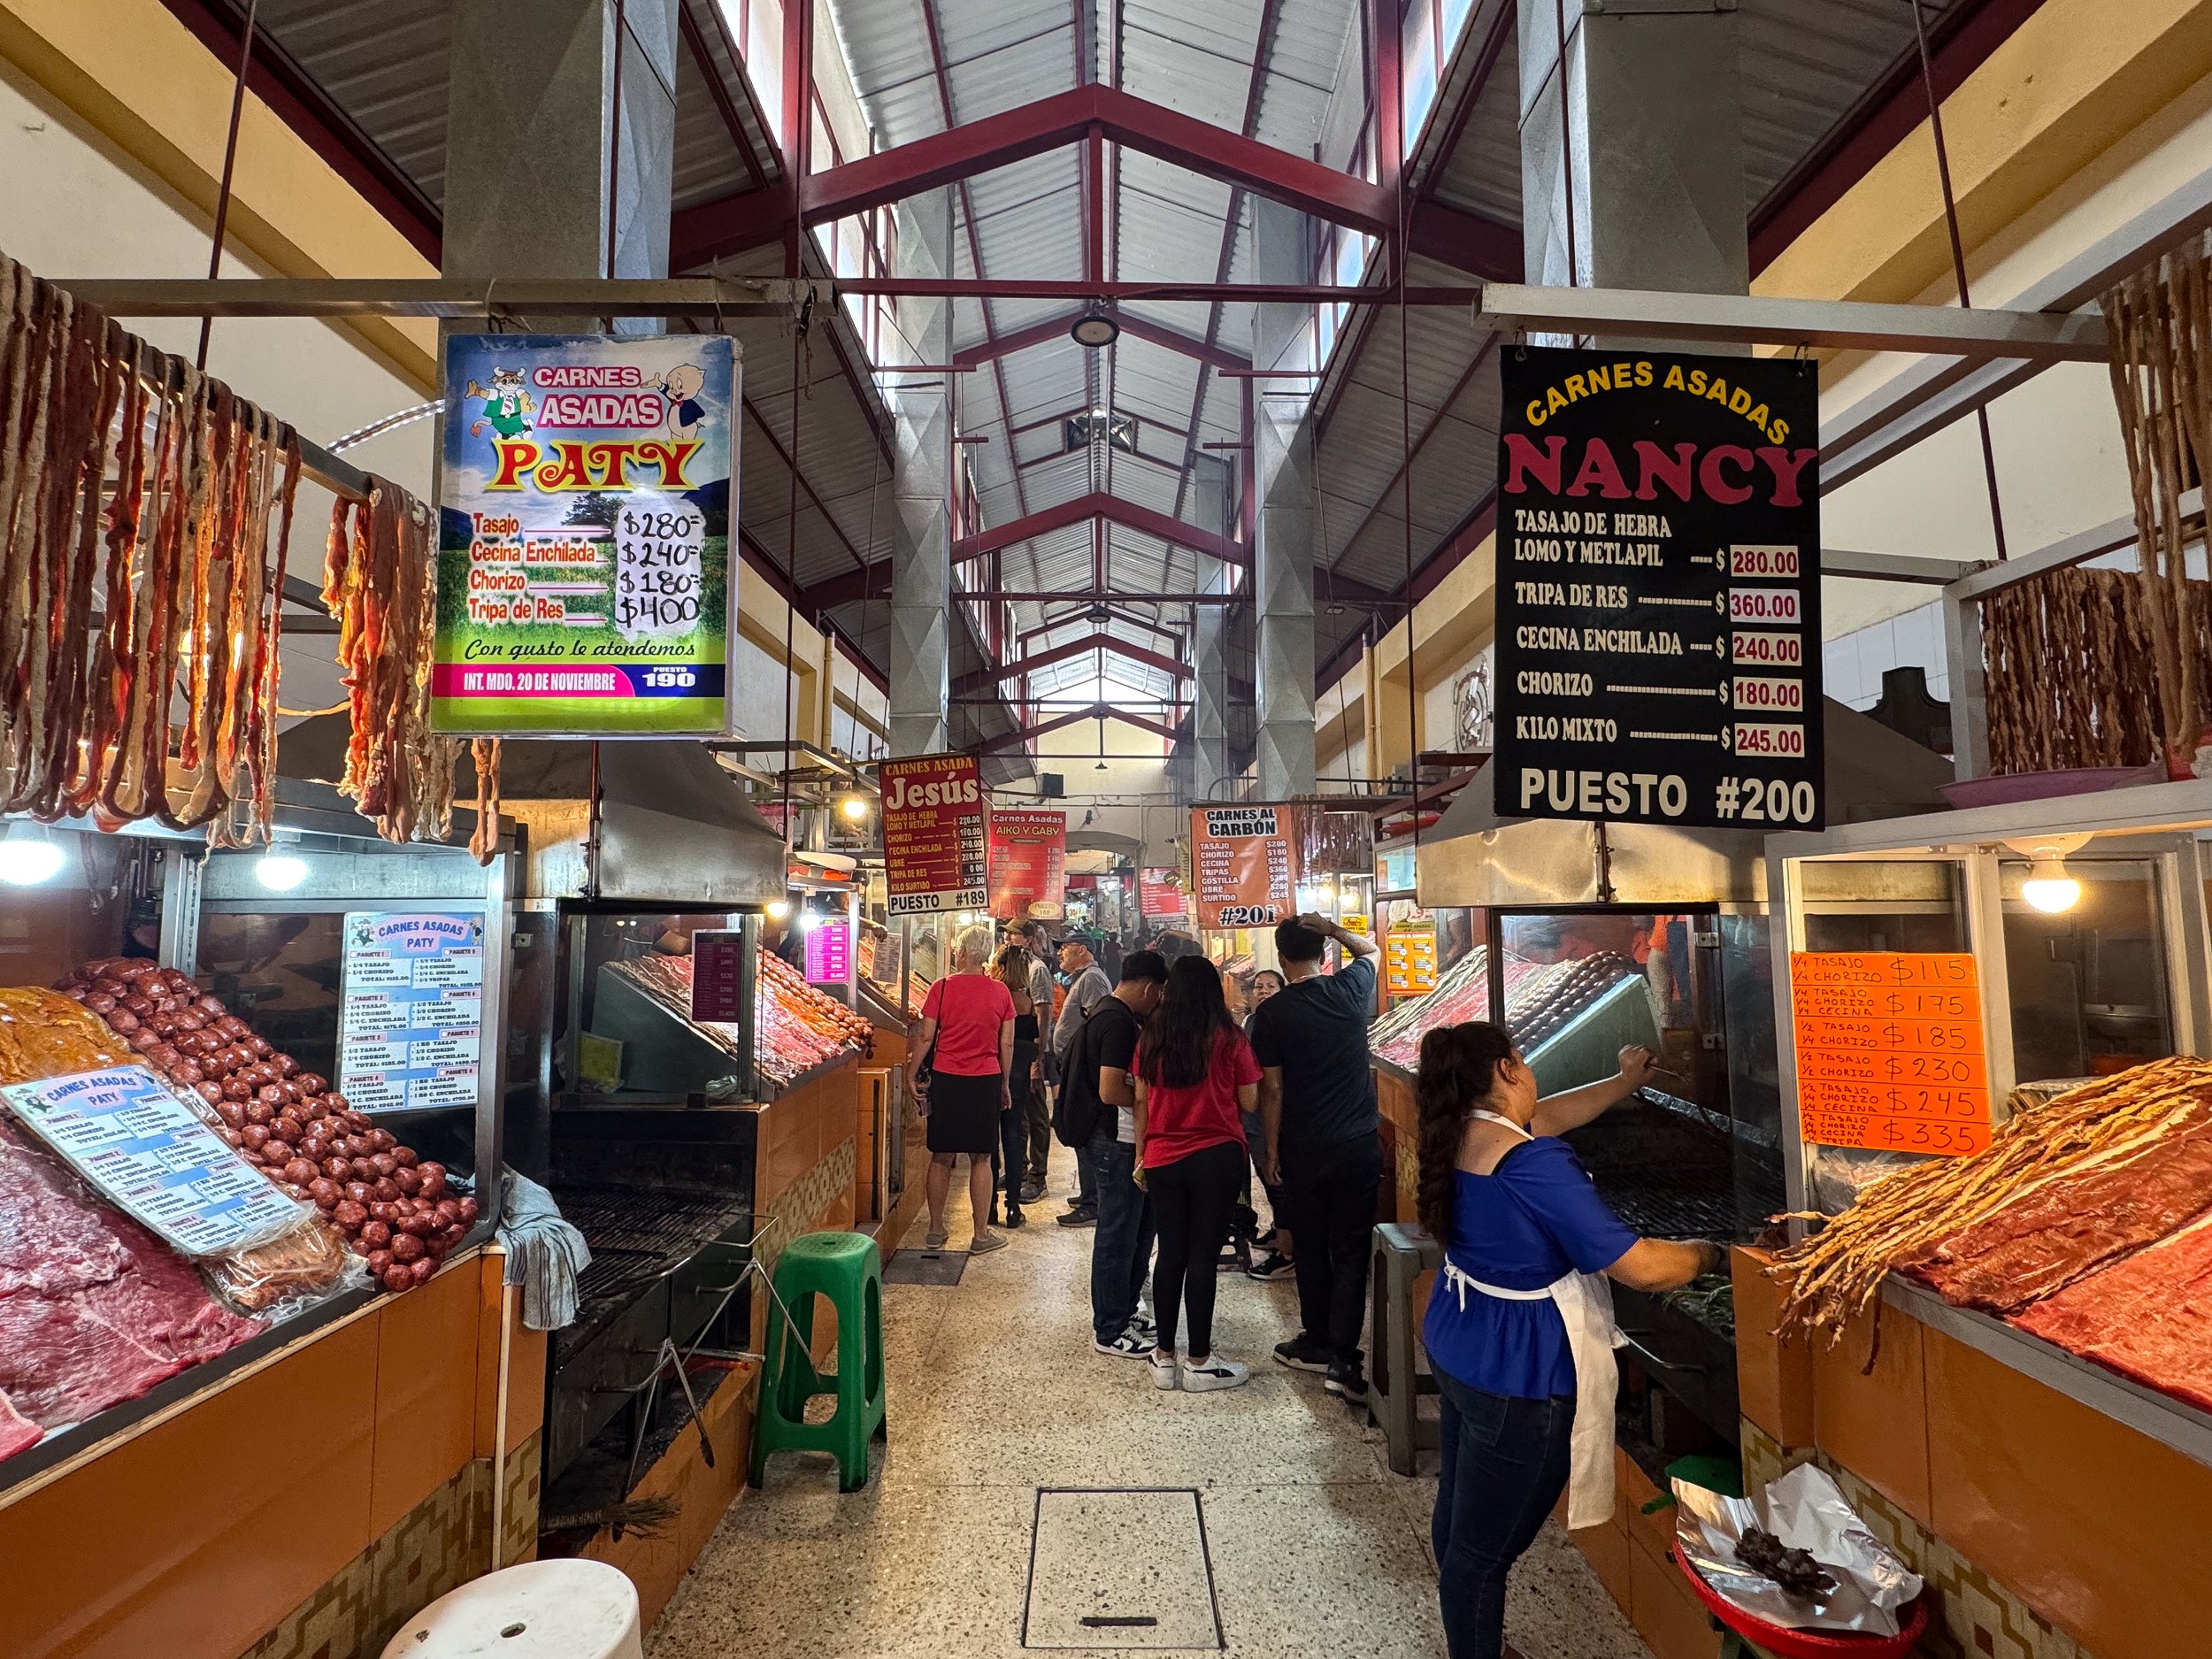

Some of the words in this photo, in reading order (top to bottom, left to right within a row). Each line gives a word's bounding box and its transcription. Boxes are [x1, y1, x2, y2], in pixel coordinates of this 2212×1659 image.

[534, 367, 641, 387] CARNES
[1526, 361, 1653, 426] CARNES
[1663, 365, 1790, 445] ASADAS
[538, 396, 662, 426] ASADAS
[486, 440, 703, 490] PATY
[1503, 433, 1817, 507] NANCY
[472, 513, 519, 537] Tasajo
[1515, 509, 1580, 534] TASAJO
[1585, 512, 1607, 535] DE
[1614, 513, 1672, 538] HEBRA
[472, 541, 520, 562] Cecina
[526, 541, 595, 562] Enchilada
[1515, 538, 1561, 563] LOMO
[1564, 540, 1577, 563] Y
[1580, 541, 1663, 567] METLAPIL
[1732, 551, 1797, 573] 280.00
[470, 569, 526, 590] Chorizo
[1515, 581, 1566, 606] TRIPA
[1569, 584, 1593, 607] DE
[1595, 585, 1628, 609] RES
[1731, 594, 1795, 618] 360.00
[469, 598, 507, 623] Tripa
[513, 598, 531, 618] de
[536, 599, 564, 618] Res
[618, 596, 701, 629] $400
[465, 640, 503, 660] Con
[508, 641, 565, 661] gusto
[569, 640, 586, 657] le
[591, 640, 695, 657] atendemos
[1517, 626, 1580, 651] CECINA
[1584, 628, 1683, 655] ENCHILADA
[1733, 636, 1800, 662] 240.00
[464, 672, 484, 691] INT.
[488, 672, 515, 691] MDO.
[518, 672, 531, 690] 20
[534, 672, 549, 690] DE
[550, 672, 616, 690] NOVIEMBRE
[641, 673, 696, 687] 190
[1517, 671, 1593, 696] CHORIZO
[1735, 681, 1801, 707] 180.00
[1516, 716, 1558, 740] KILO
[1562, 718, 1617, 742] MIXTO
[1737, 728, 1801, 753] 245.00
[885, 761, 930, 776] CARNES
[934, 757, 973, 772] ASADA
[886, 772, 979, 810] Jesús
[1521, 767, 1687, 817] PUESTO
[1716, 777, 1815, 823] #200
[887, 812, 907, 822] TASAJO
[909, 811, 916, 821] DE
[918, 810, 938, 820] HEBRA
[993, 814, 1025, 823] Carnes
[1028, 814, 1063, 824] Asadas
[1206, 809, 1257, 821] CARNES
[1259, 809, 1275, 818] AL
[887, 822, 902, 831] LOMO
[903, 821, 908, 830] Y
[909, 819, 936, 829] METLAPIL
[996, 826, 1020, 835] AIKO
[1022, 826, 1031, 835] Y
[1032, 826, 1060, 836] GABY
[1209, 819, 1276, 836] CARBÓN
[887, 833, 912, 843] CHORIZO
[911, 843, 942, 853] ENCHILADA
[890, 858, 904, 867] UBRE
[890, 870, 907, 879] TRIPA
[908, 869, 915, 878] DE
[917, 868, 927, 877] RES
[891, 882, 905, 892] KILO
[906, 881, 930, 891] SURTIDO
[891, 894, 940, 911] PUESTO
[956, 890, 985, 906] #189
[1219, 906, 1276, 926] #201
[379, 920, 419, 936] CARNES
[423, 921, 464, 935] ASADAS
[407, 938, 434, 948] PATY
[1813, 957, 1863, 968] TASAJO
[1814, 971, 1882, 983] CHORIZO
[1813, 988, 1867, 997] TASAJO
[1815, 997, 1874, 1006] CHORIZO
[1819, 1007, 1872, 1016] CECINA
[1801, 1020, 1815, 1033] 1/2
[1823, 1022, 1870, 1033] TASAJO
[1820, 1035, 1878, 1048] CHORIZO
[1801, 1051, 1812, 1061] 1/2
[1817, 1053, 1870, 1064] TASAJO
[1802, 1064, 1814, 1076] 1/2
[1820, 1068, 1874, 1078] CHORIZO
[47, 1080, 89, 1102] CARNES
[90, 1077, 137, 1087] ASADAS
[1819, 1083, 1869, 1094] TASAJO
[88, 1092, 119, 1106] PATY
[1820, 1093, 1878, 1104] CHORIZO
[1824, 1102, 1878, 1113] CECINA
[1819, 1114, 1869, 1124] TASAJO
[1820, 1122, 1866, 1131] CHORIZO
[1822, 1137, 1863, 1147] TRIPA
